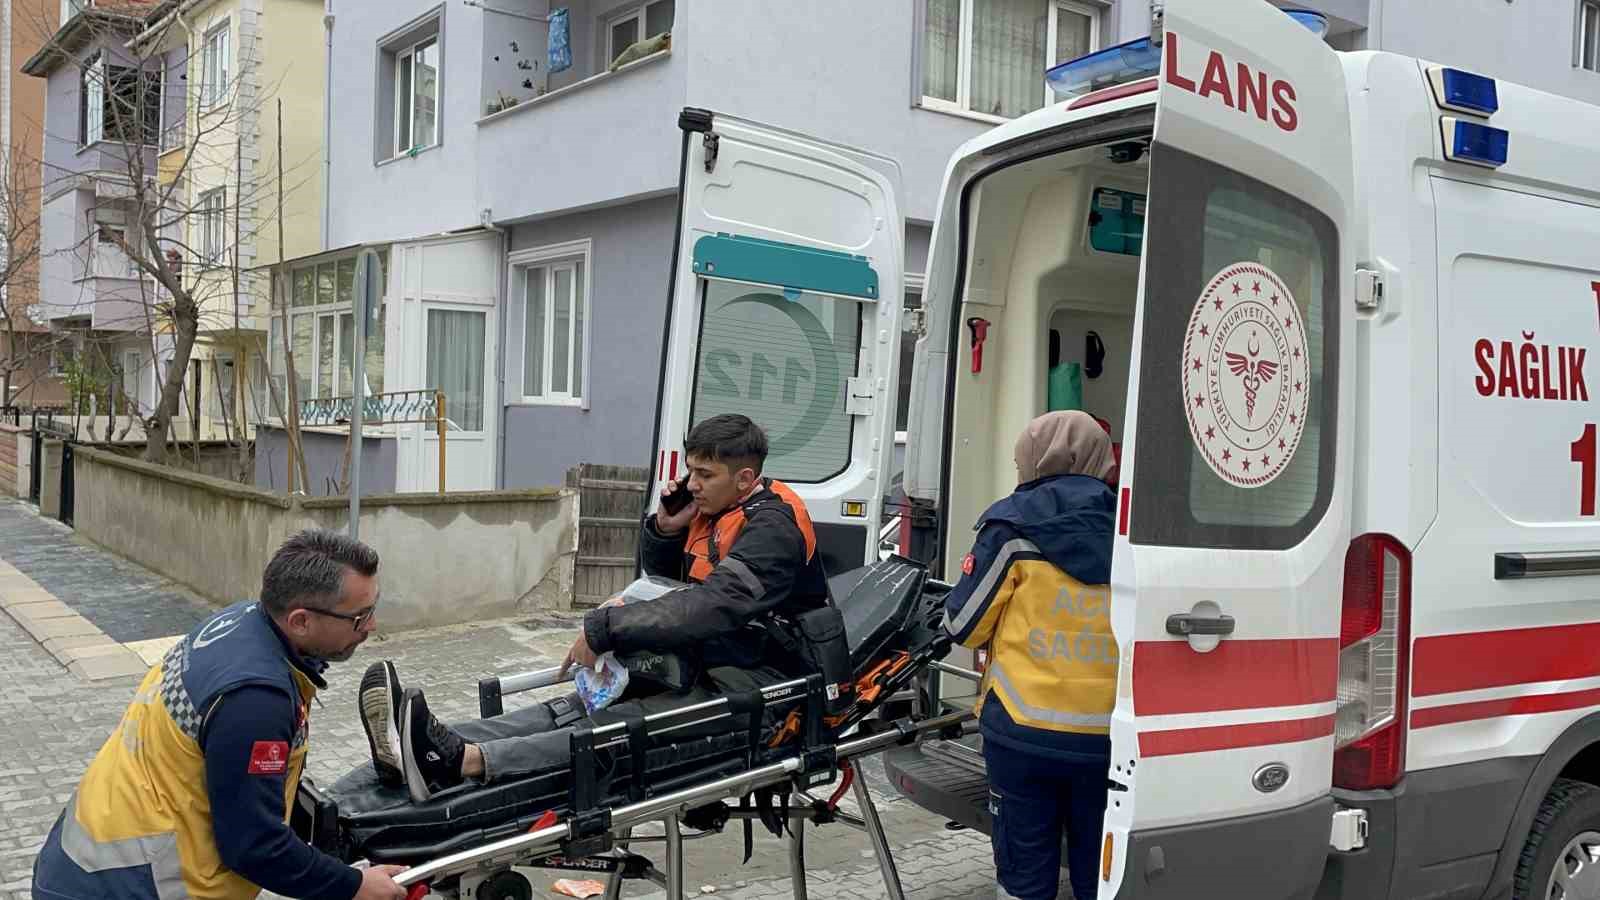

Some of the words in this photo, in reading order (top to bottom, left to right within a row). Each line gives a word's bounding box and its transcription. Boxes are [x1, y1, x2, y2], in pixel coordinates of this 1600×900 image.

[1165, 31, 1298, 133] LANS
[1474, 330, 1589, 402] SAĞLIK
[1027, 624, 1120, 665] SAĞL
